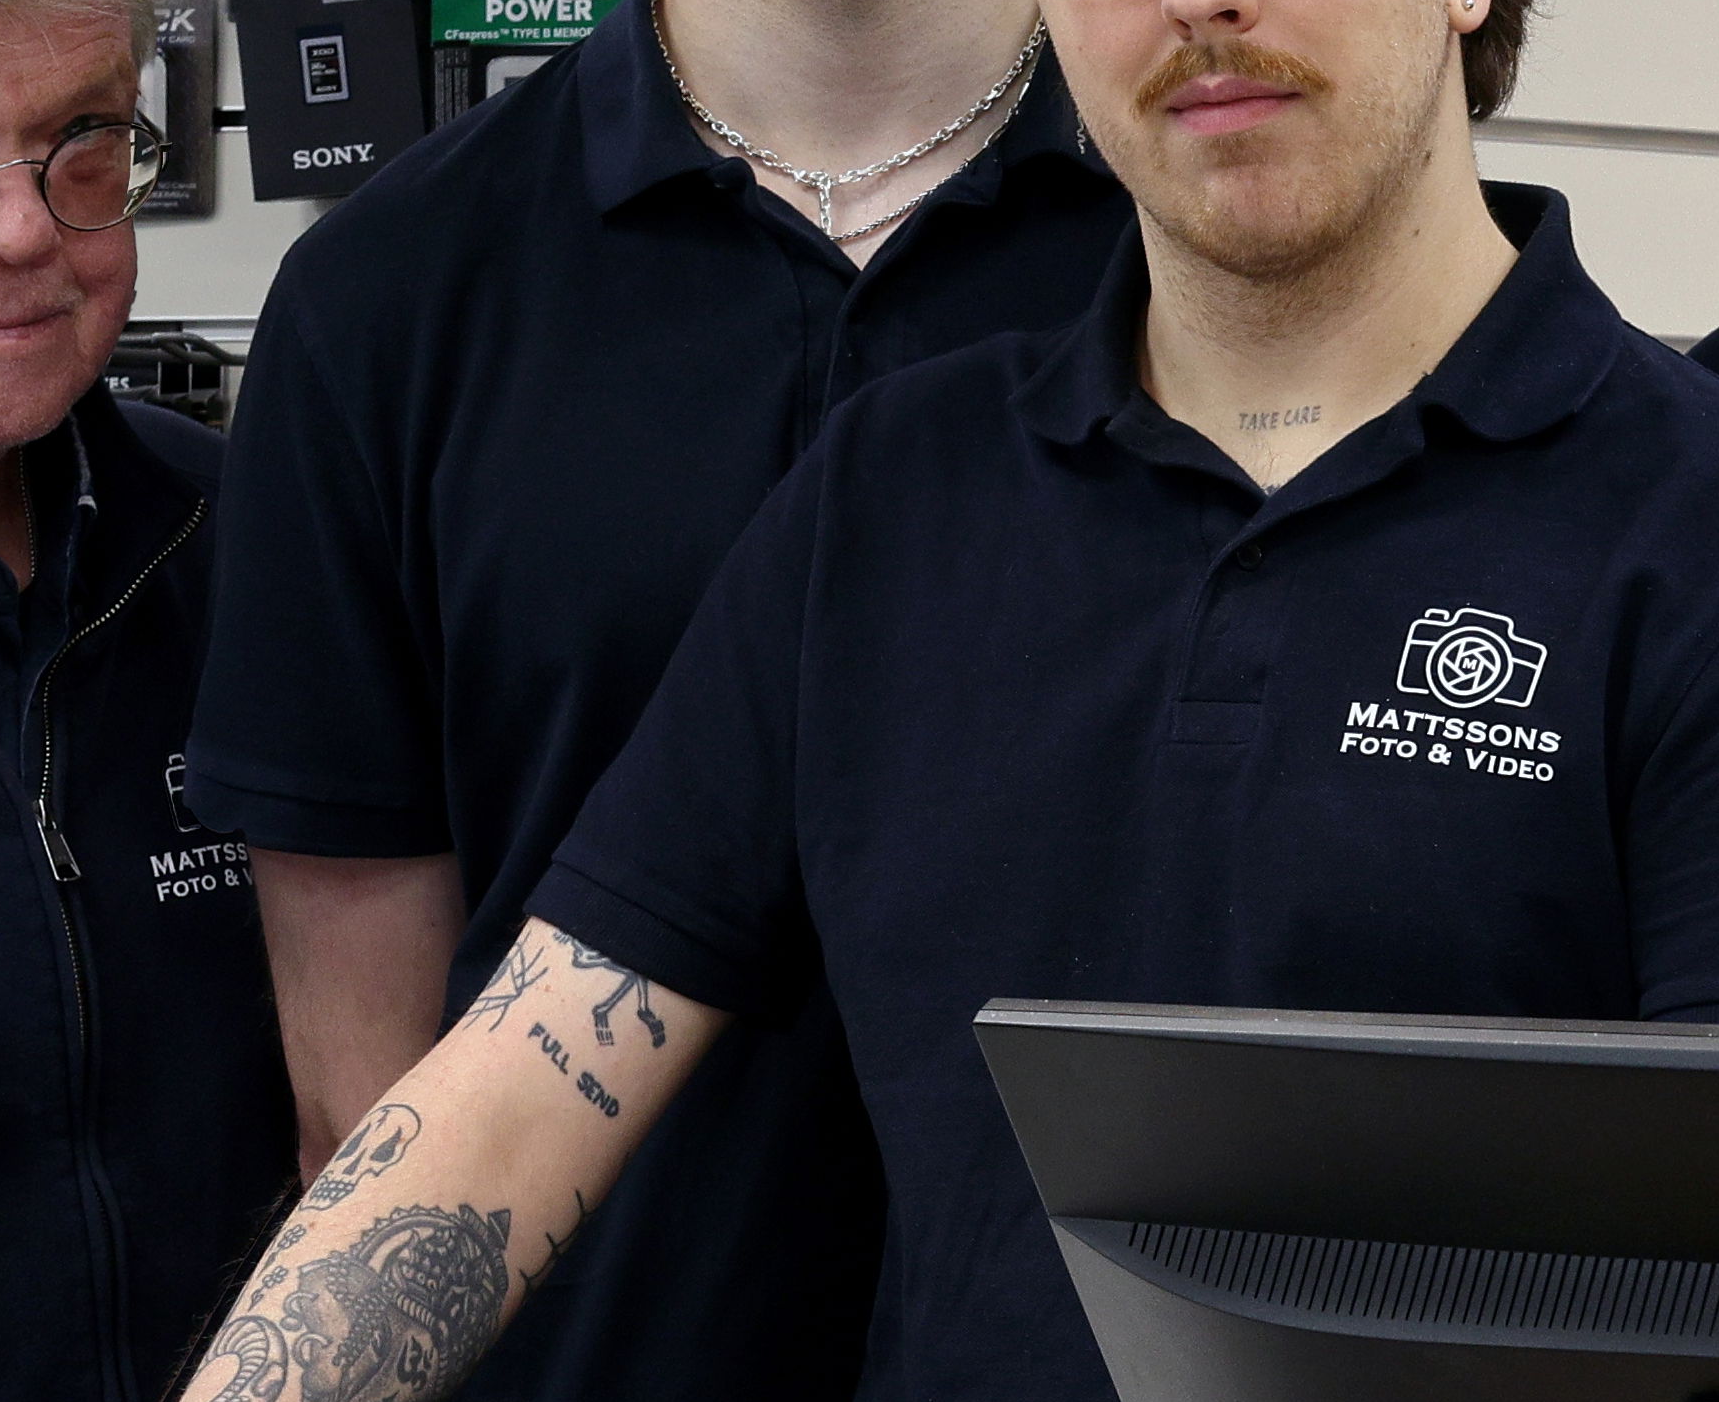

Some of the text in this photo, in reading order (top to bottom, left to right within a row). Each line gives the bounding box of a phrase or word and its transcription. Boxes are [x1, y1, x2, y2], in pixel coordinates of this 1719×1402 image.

[513, 28, 551, 39] TYPE B
[293, 144, 374, 170] SONY
[1238, 405, 1322, 431] TAKE CARE
[1462, 656, 1478, 671] M
[1346, 701, 1562, 754] MATTSSONS
[1339, 731, 1555, 783] FOTO & VIDEO
[149, 842, 248, 877] MATTSS
[156, 874, 217, 902] FOTO
[224, 868, 240, 887] &
[527, 1021, 620, 1118] FULL SEND
